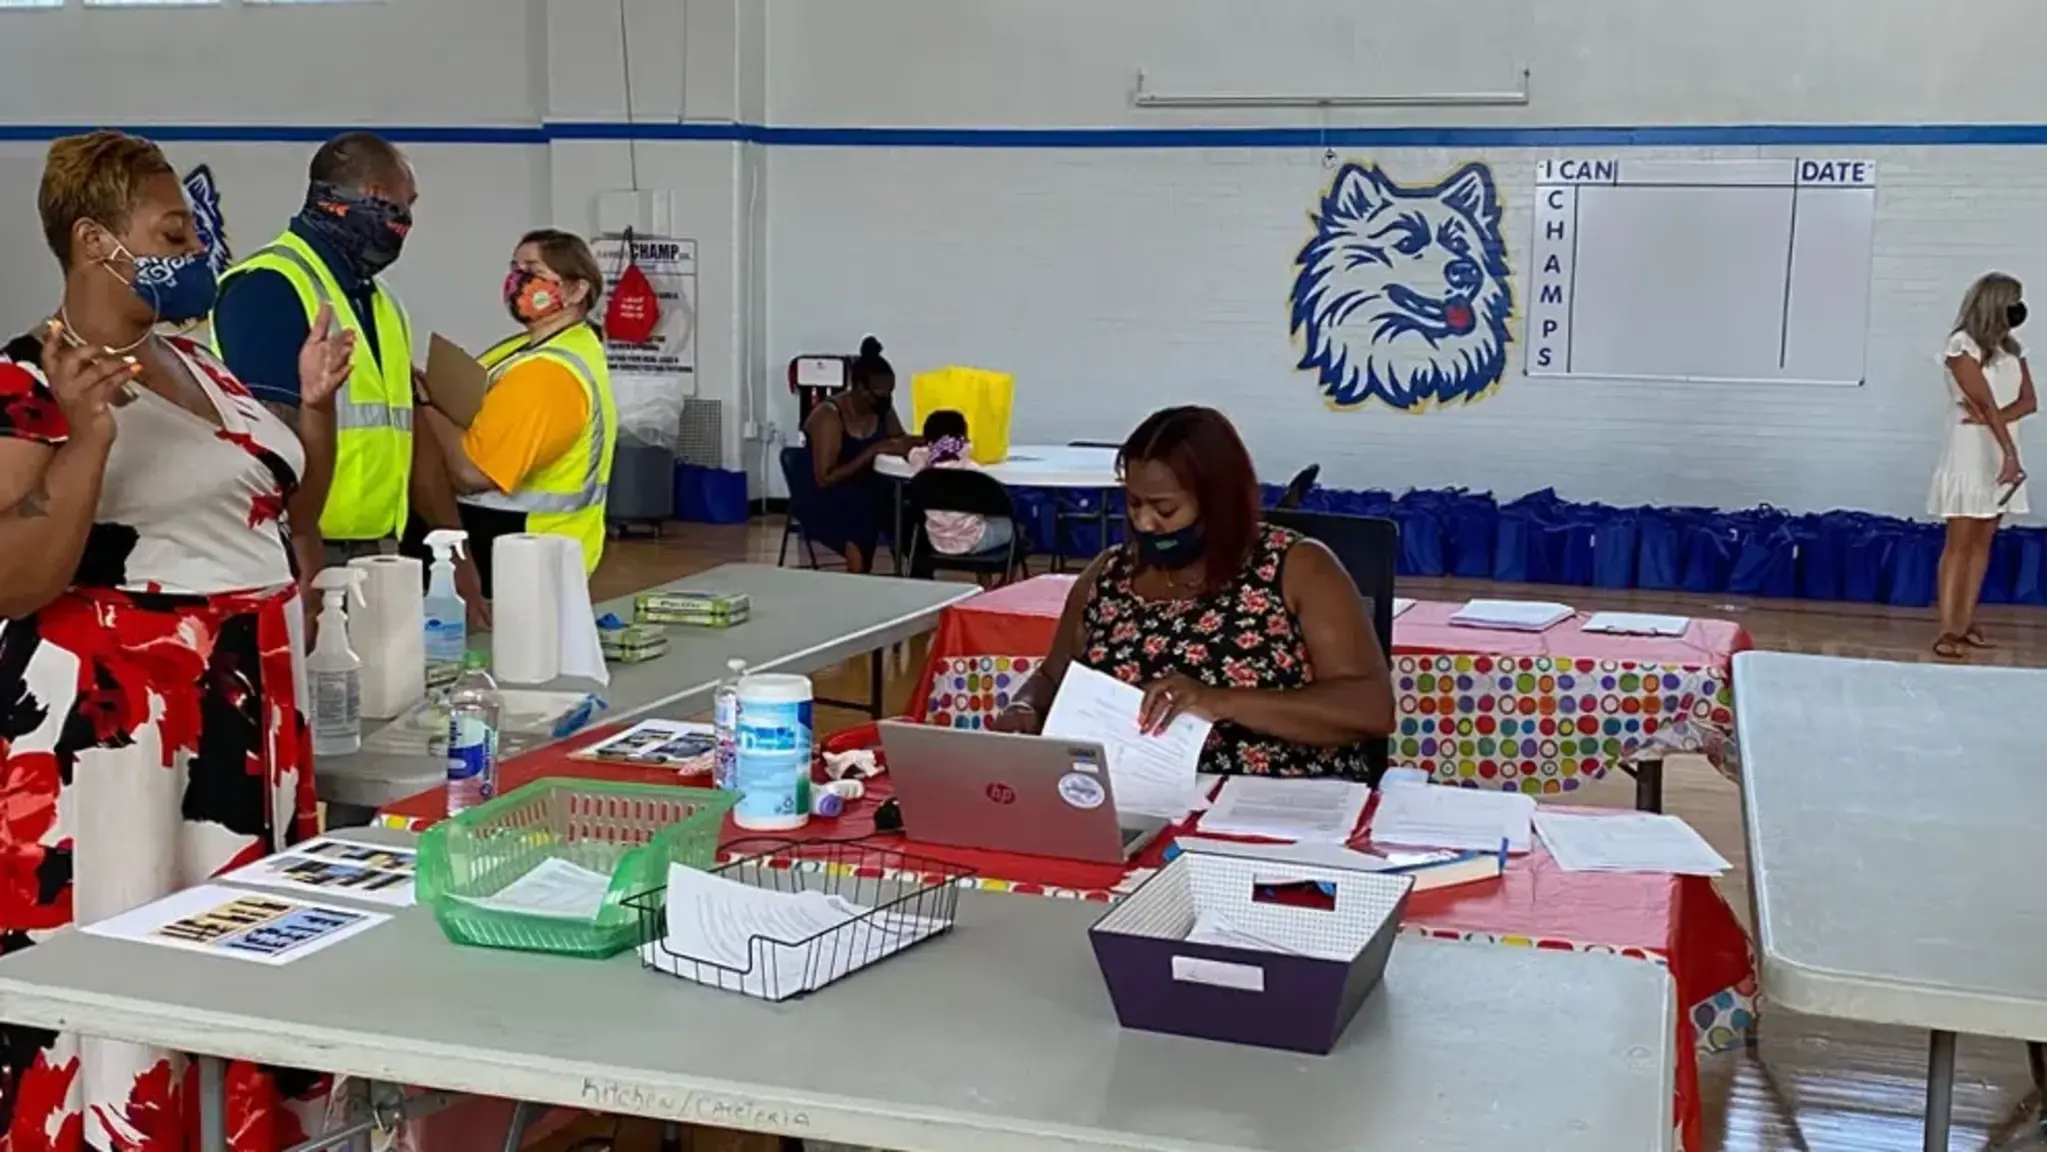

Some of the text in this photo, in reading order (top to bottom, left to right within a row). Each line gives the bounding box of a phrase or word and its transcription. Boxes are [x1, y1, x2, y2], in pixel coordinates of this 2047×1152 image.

[1545, 161, 1613, 180] I CAN
[1801, 162, 1865, 182] DATE
[631, 243, 680, 260] CHAMP
[989, 782, 1014, 804] hp
